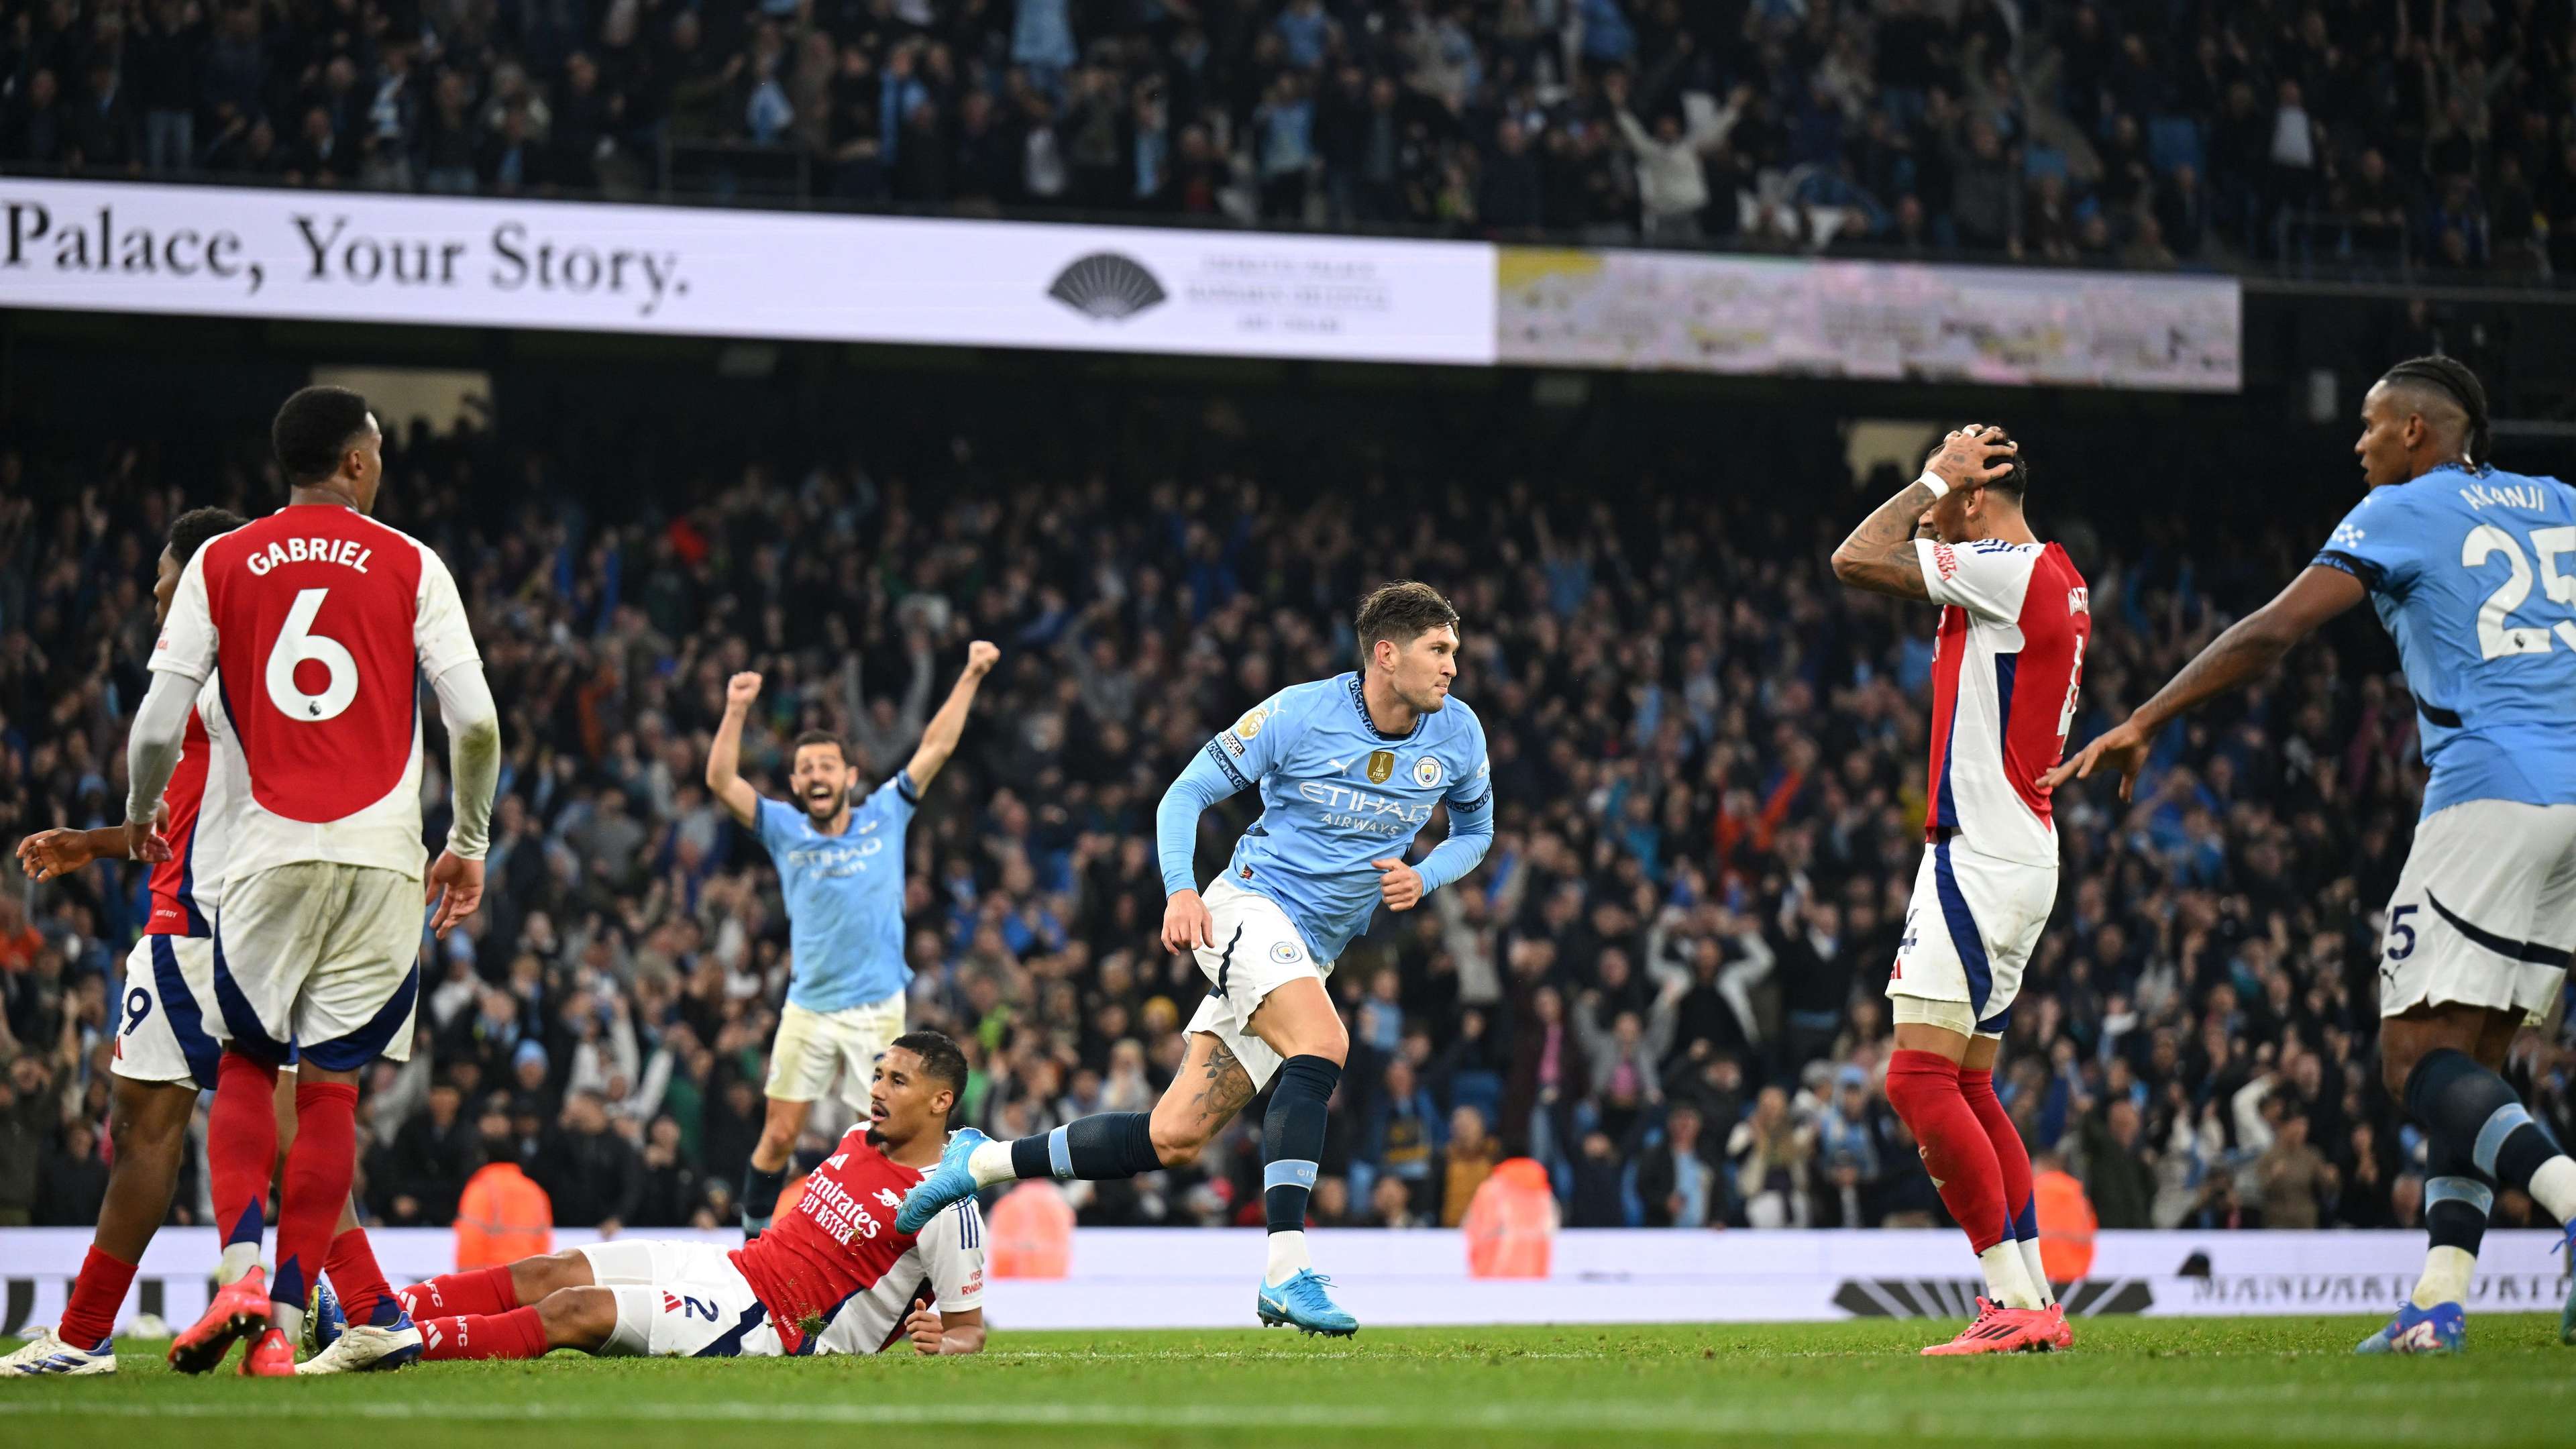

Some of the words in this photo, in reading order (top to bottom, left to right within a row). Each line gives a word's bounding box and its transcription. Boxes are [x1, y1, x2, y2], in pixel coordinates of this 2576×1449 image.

[2, 201, 264, 295] Palace,
[290, 213, 467, 286] Your
[488, 220, 691, 316] Story.
[2459, 483, 2544, 513] AKANJI
[246, 537, 373, 576] GABRIEL
[2461, 523, 2576, 661] 25
[265, 588, 358, 722] 6
[1299, 782, 1433, 822] ETIHAD
[1322, 812, 1399, 836] AIRWAYS
[806, 1167, 881, 1239] Emirates
[424, 1279, 443, 1308] AFC
[684, 1295, 719, 1322] 2
[456, 1316, 468, 1347] AFC
